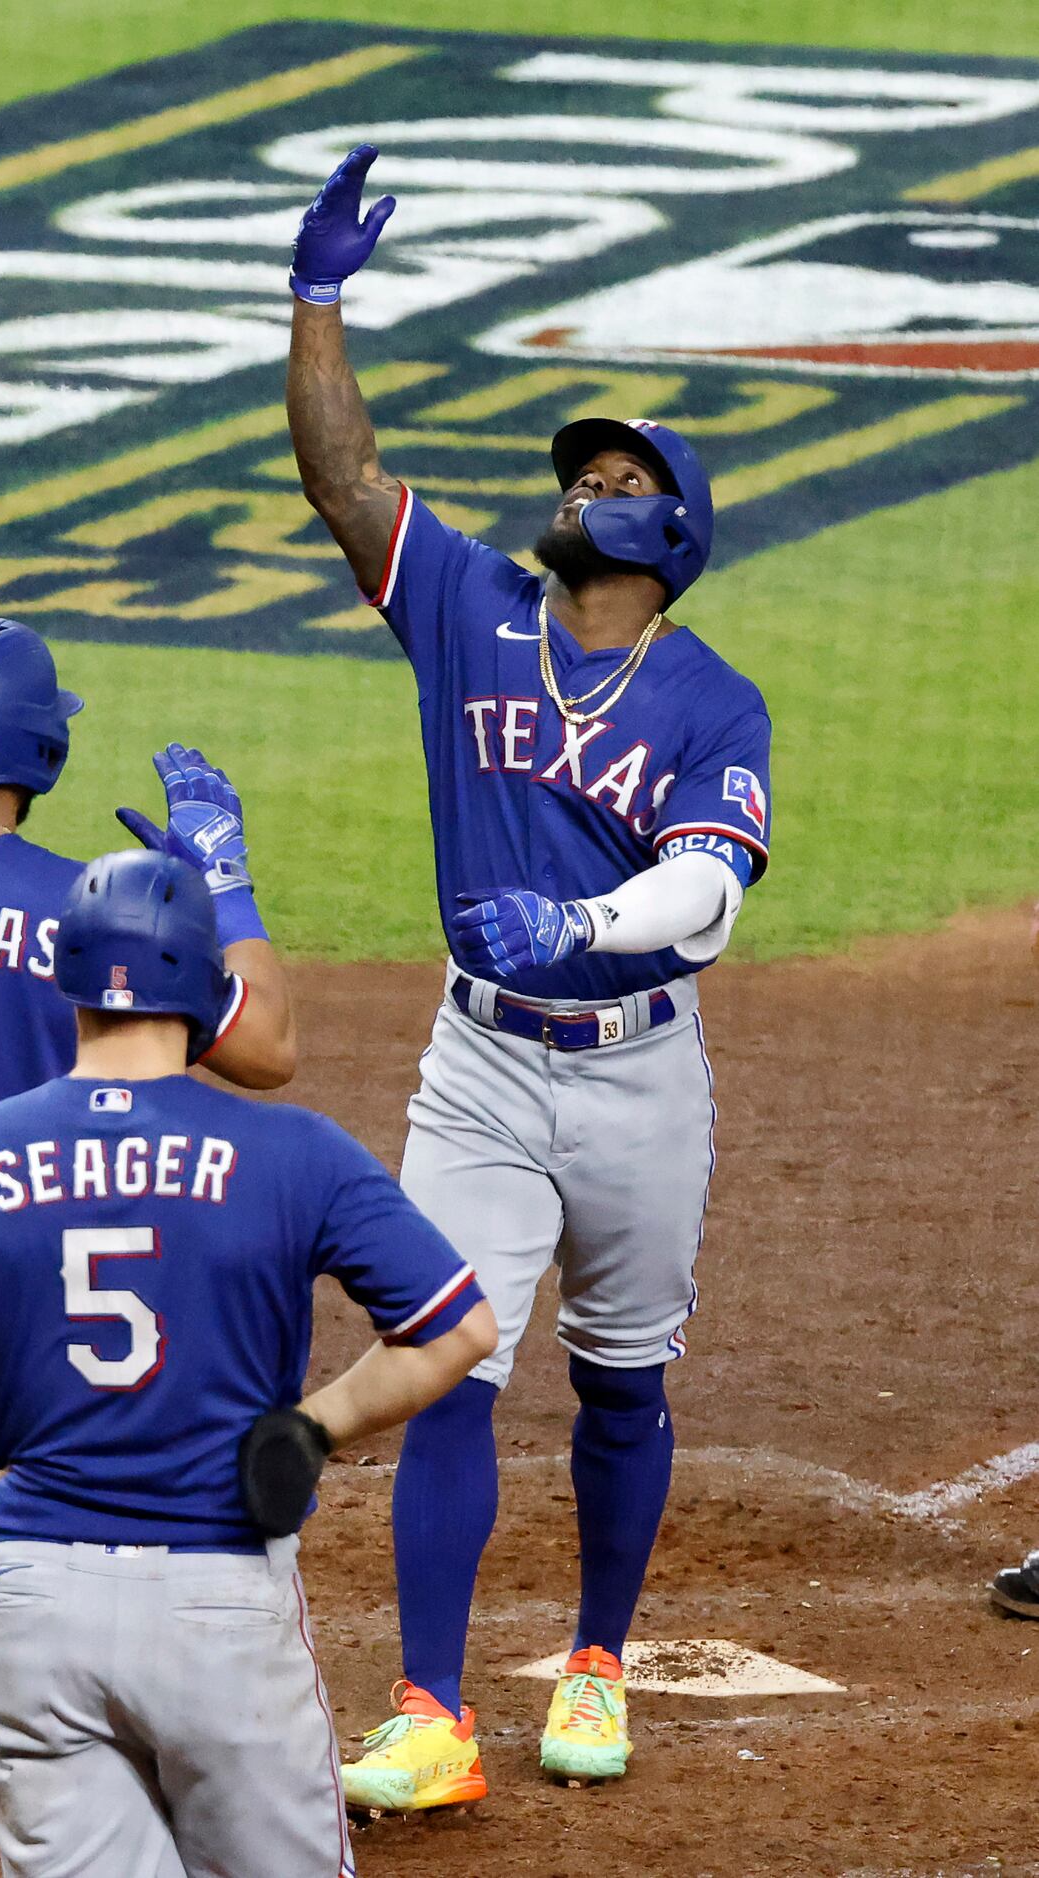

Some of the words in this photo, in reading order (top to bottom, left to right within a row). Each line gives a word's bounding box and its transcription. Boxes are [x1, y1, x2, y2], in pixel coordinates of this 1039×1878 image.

[463, 694, 675, 836] TEXAS
[110, 965, 127, 989] 5
[604, 1021, 618, 1040] 53
[59, 1226, 169, 1392] 5
